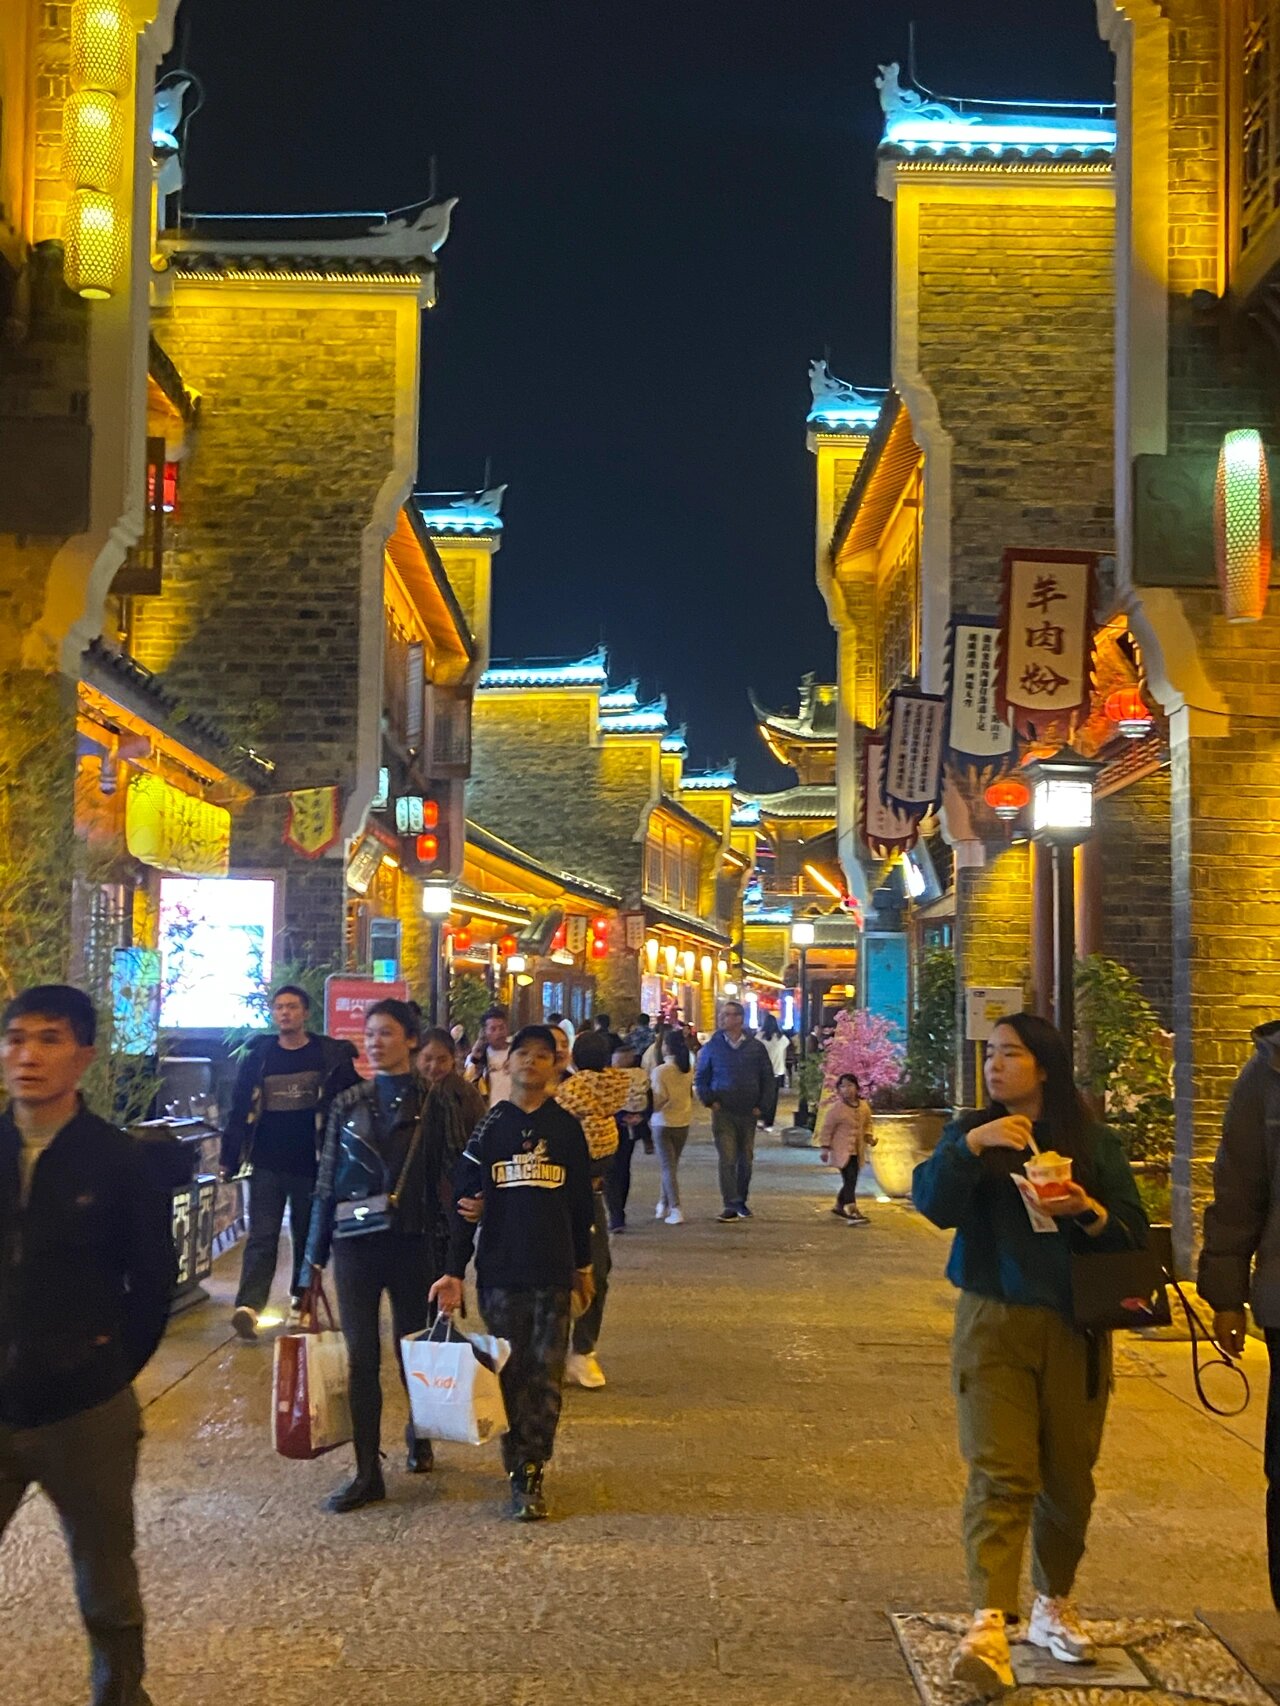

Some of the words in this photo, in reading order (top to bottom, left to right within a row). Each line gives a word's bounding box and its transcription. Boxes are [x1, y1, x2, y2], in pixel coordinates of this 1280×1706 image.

[1019, 575, 1069, 697] 羊肉粉
[496, 1164, 561, 1183] ARACHNID
